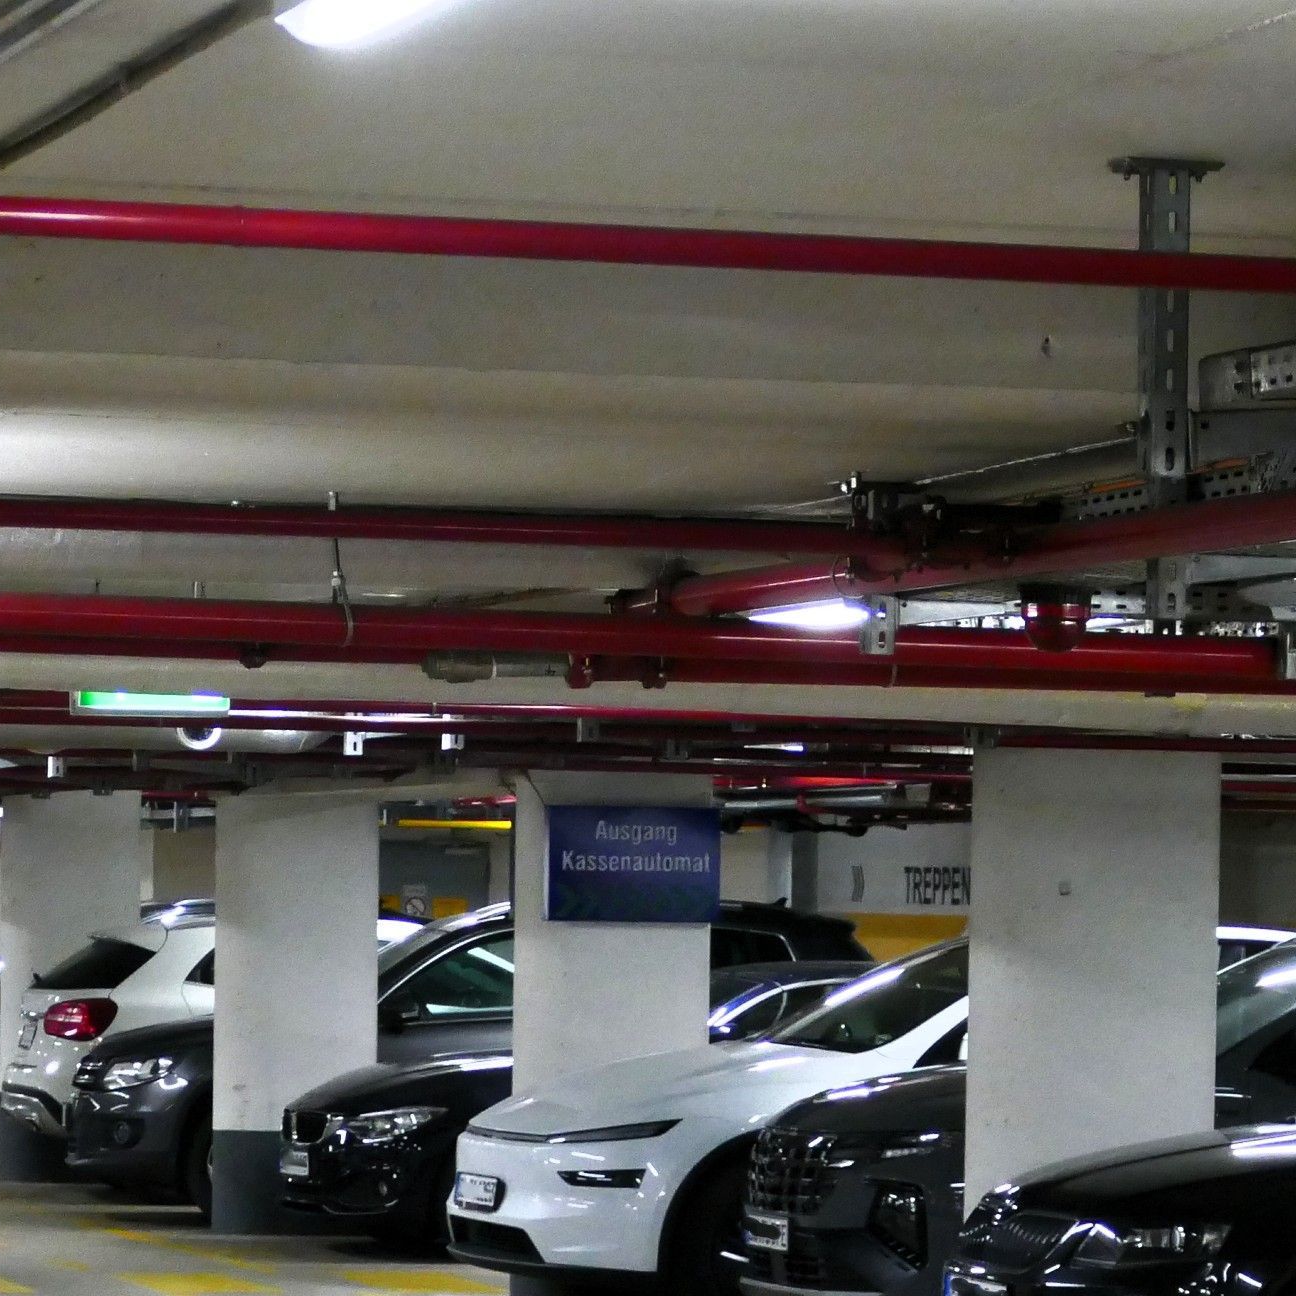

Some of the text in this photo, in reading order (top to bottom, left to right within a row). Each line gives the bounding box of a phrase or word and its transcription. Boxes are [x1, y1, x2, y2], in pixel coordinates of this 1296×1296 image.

[595, 820, 677, 846] Ausgang
[561, 850, 710, 873] Kassenautomat
[904, 866, 971, 906] TREPPEN
